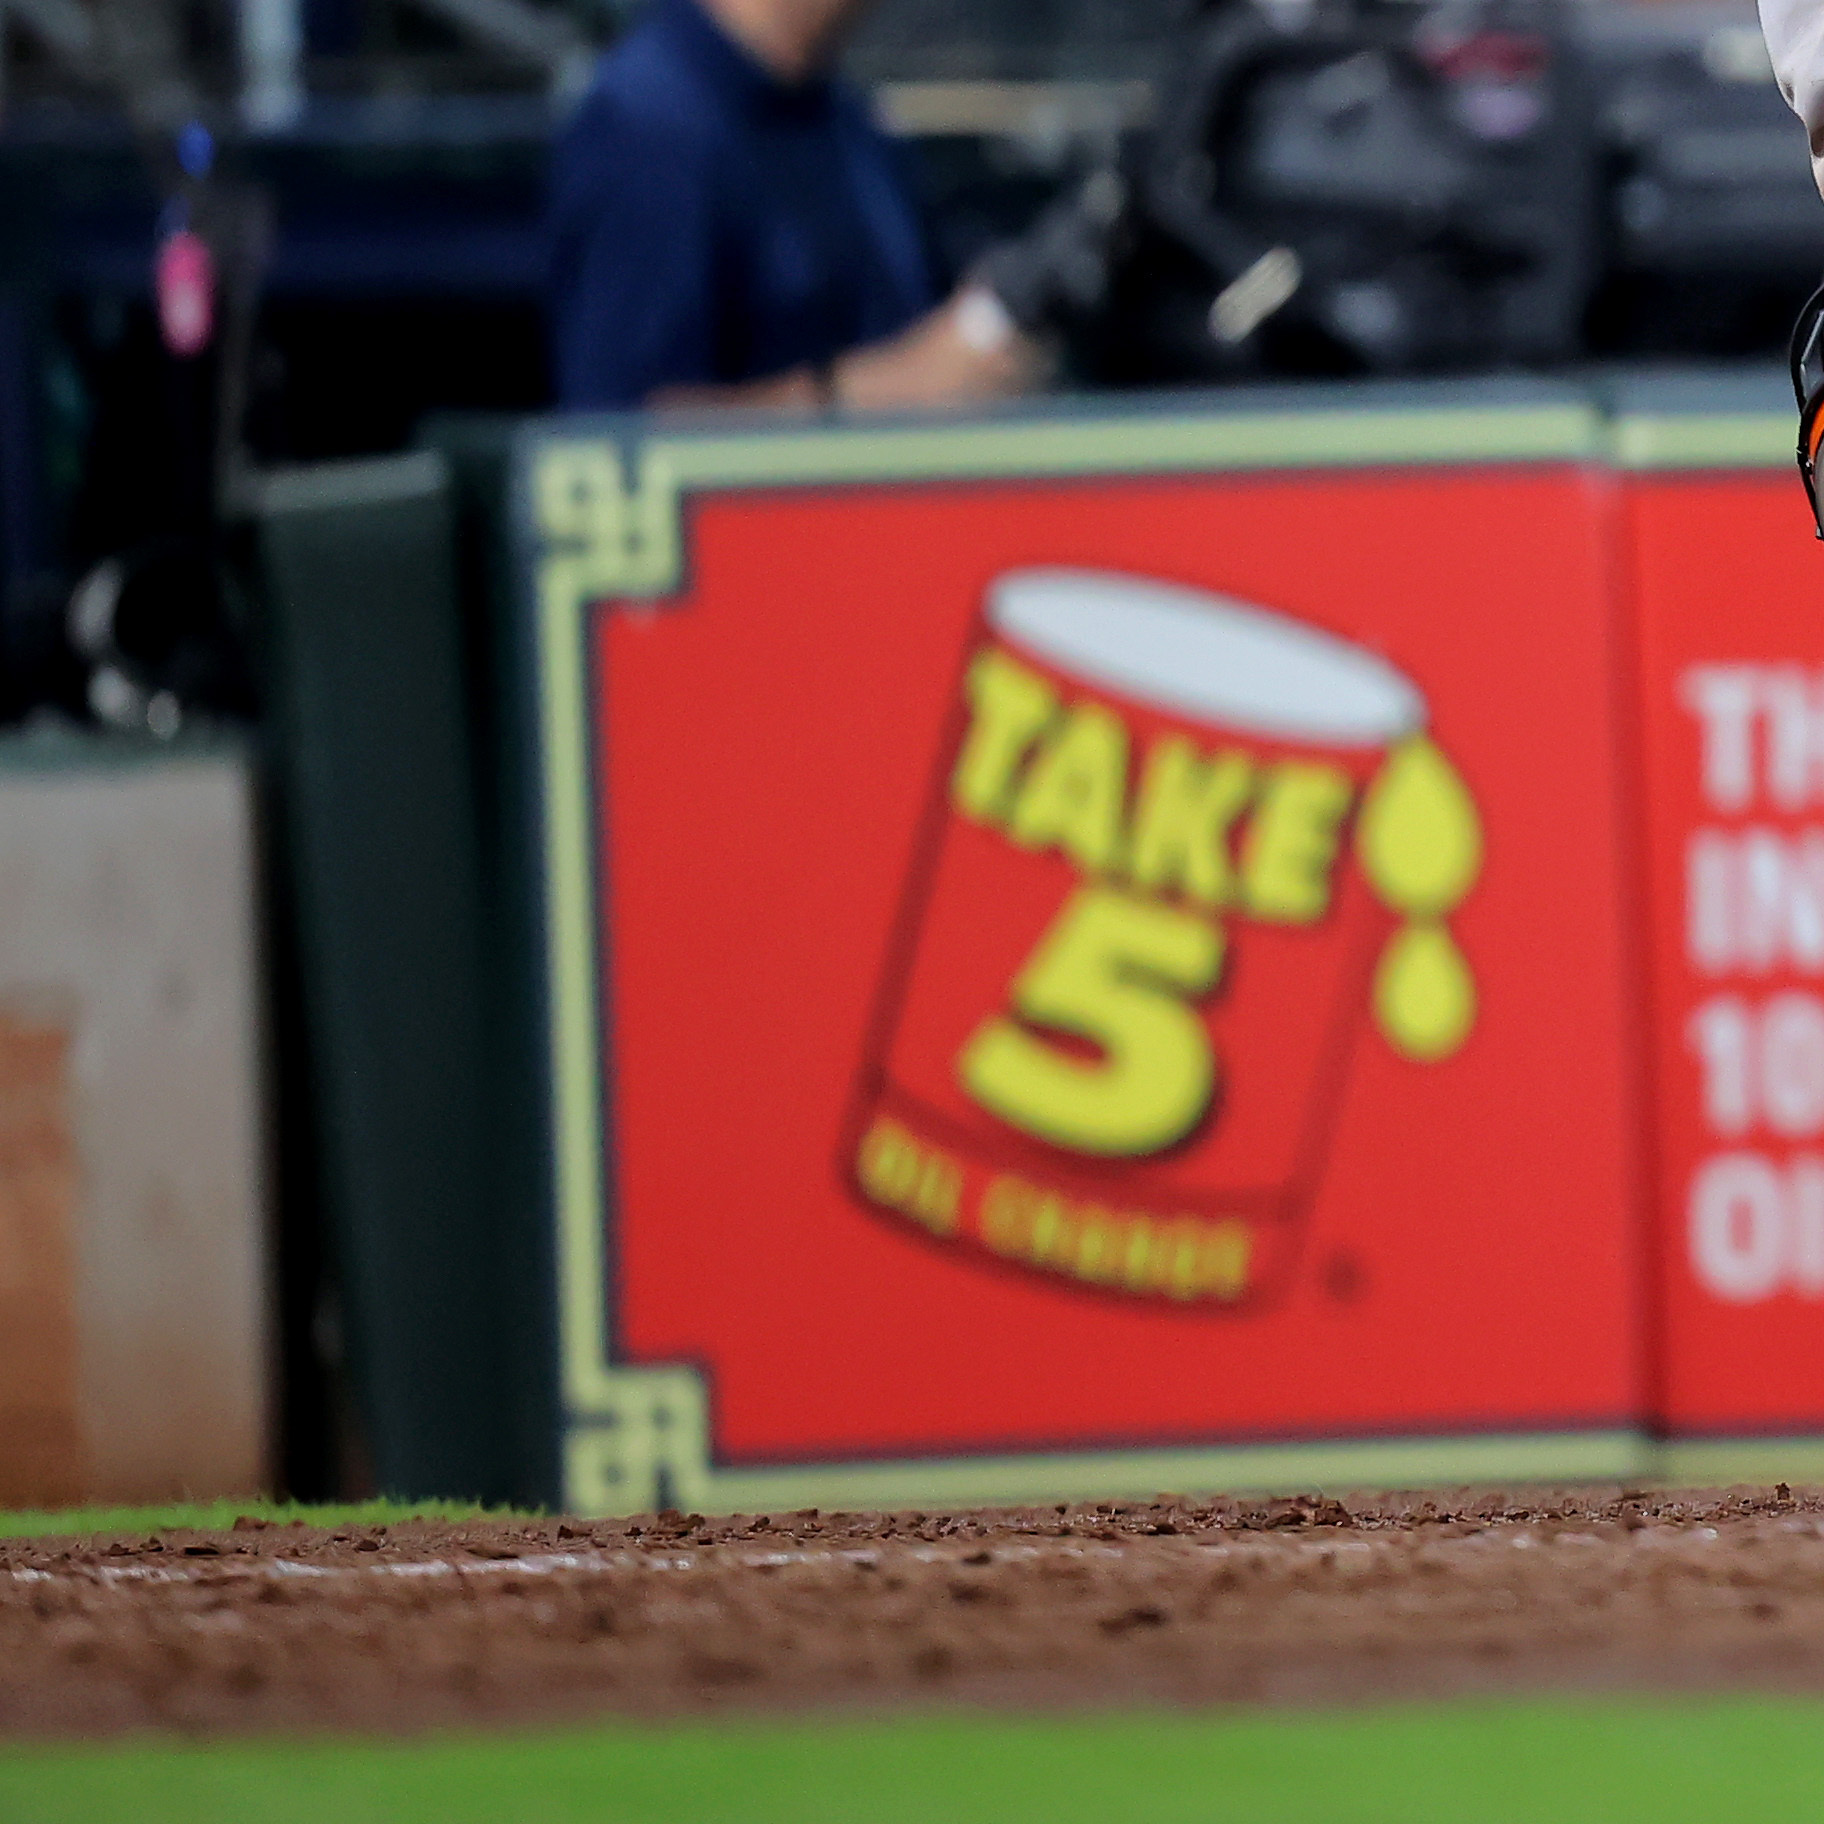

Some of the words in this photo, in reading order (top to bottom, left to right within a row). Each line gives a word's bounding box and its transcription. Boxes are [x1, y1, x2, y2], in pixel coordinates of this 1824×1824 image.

[953, 646, 1352, 924] TAKE
[955, 878, 1225, 1158] 5
[858, 1118, 962, 1236] OIL
